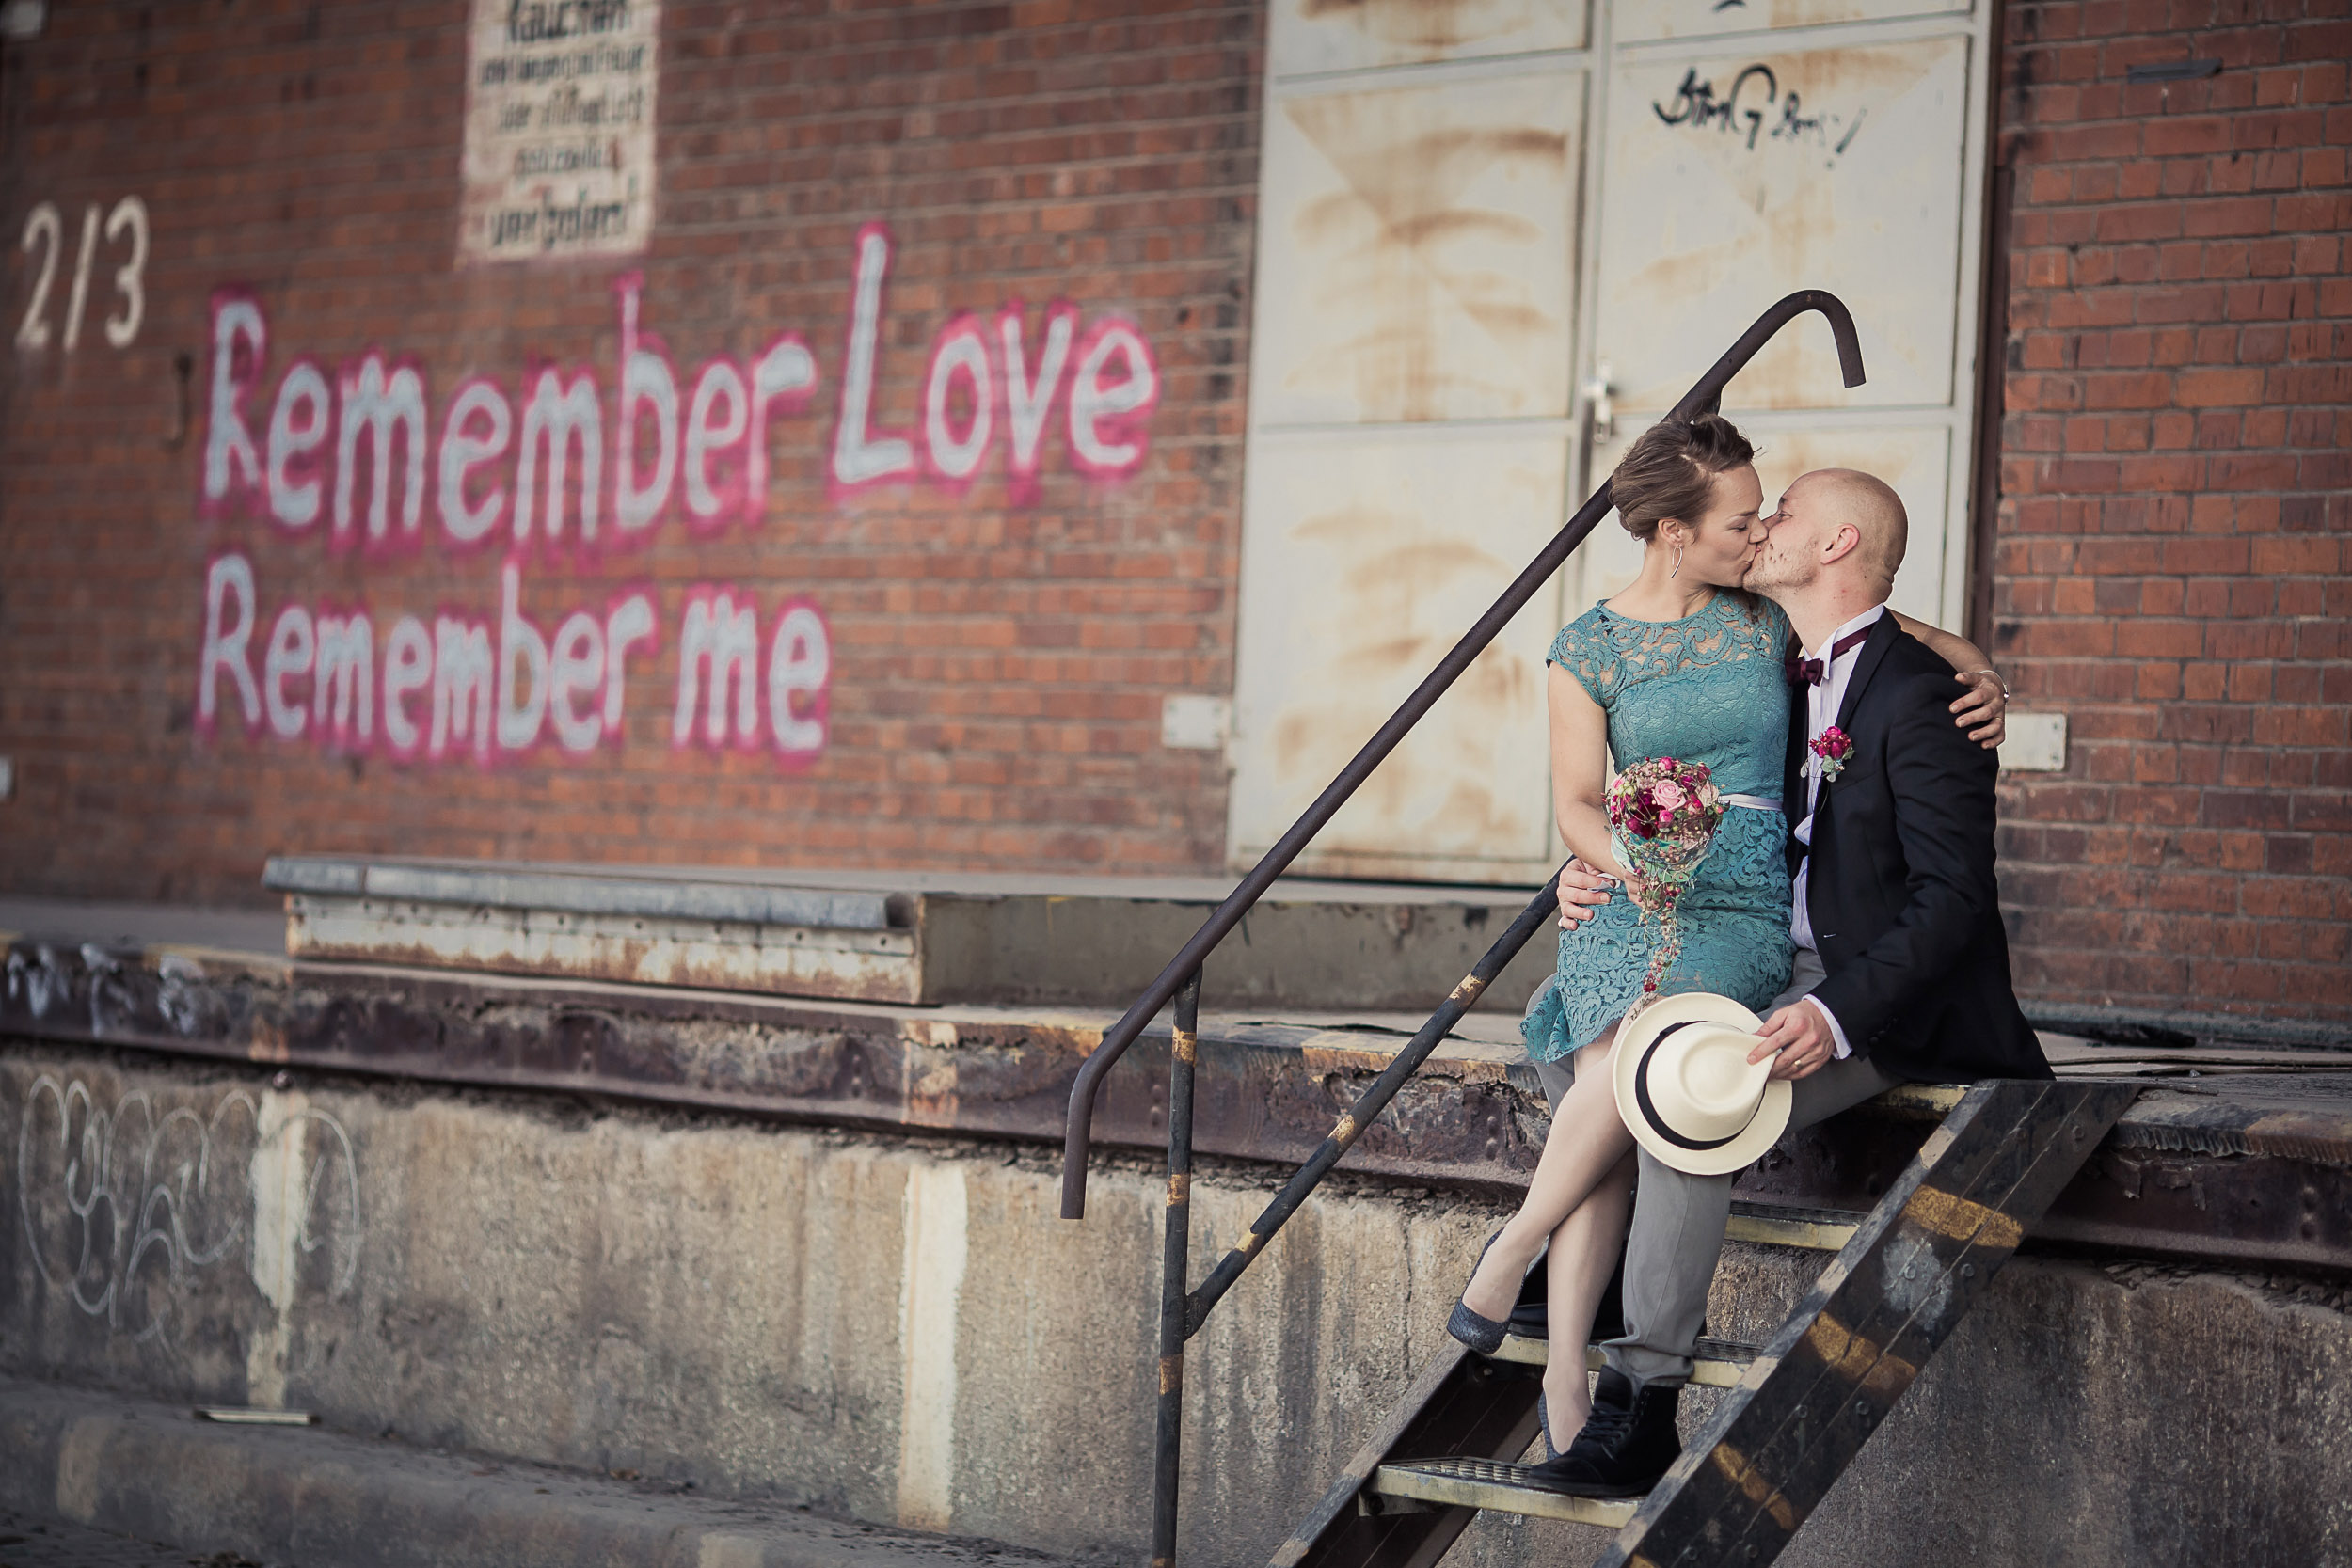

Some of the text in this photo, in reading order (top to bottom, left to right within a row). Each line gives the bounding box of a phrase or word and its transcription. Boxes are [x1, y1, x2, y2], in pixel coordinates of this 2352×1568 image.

[14, 194, 151, 353] 2/3
[201, 222, 1159, 555] Remember Love
[196, 549, 832, 764] Remember me
